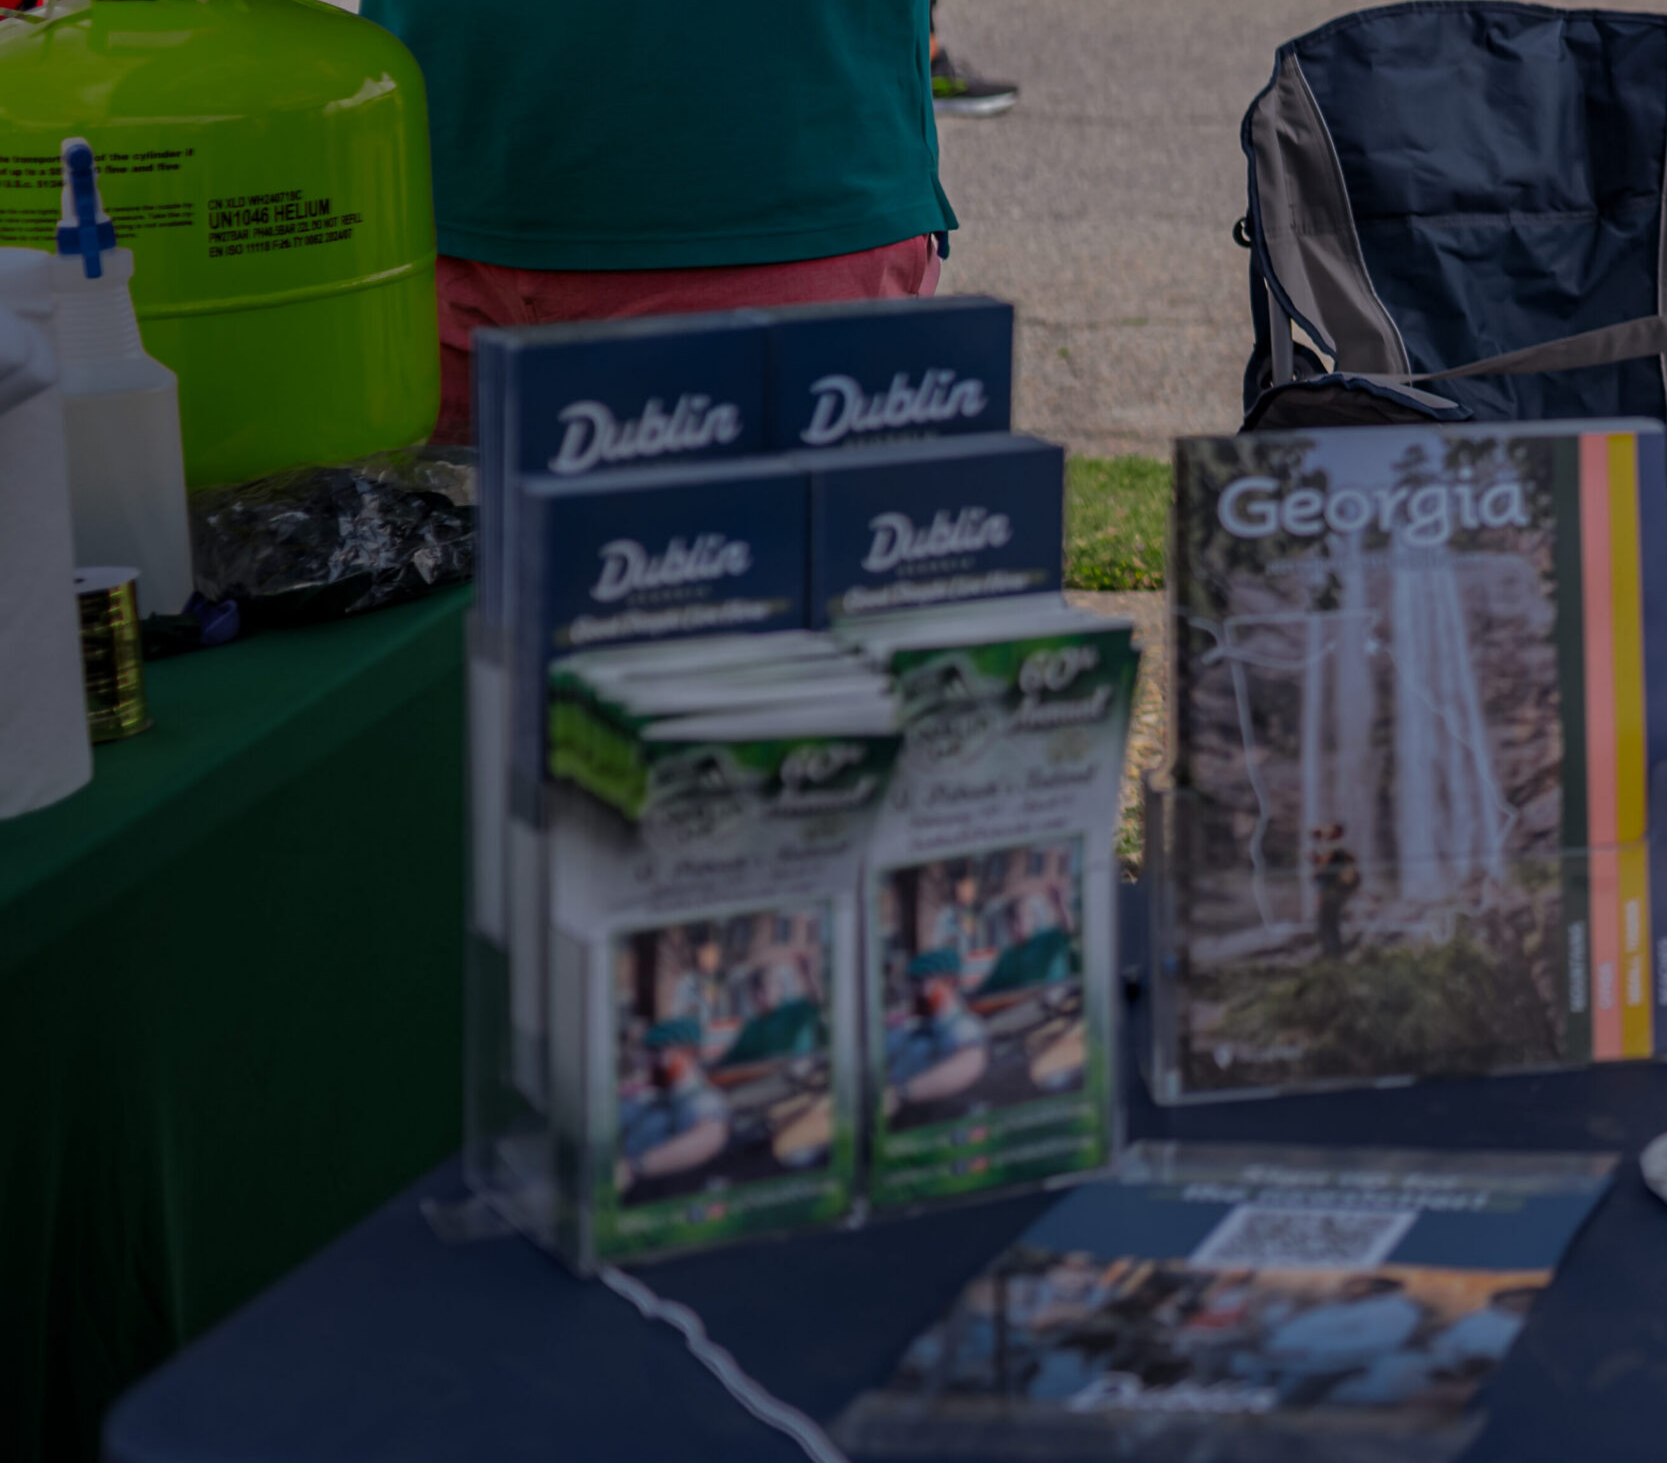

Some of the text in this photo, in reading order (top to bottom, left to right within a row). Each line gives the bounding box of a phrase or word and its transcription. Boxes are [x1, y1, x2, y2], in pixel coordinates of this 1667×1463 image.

[208, 207, 270, 230] UN1046
[274, 197, 330, 222] HELIUM
[547, 392, 744, 476] Dublin
[800, 367, 990, 446] Dublin
[861, 505, 1014, 574] Dublin
[1216, 468, 1532, 548] Georgia
[590, 532, 754, 604] Dublin
